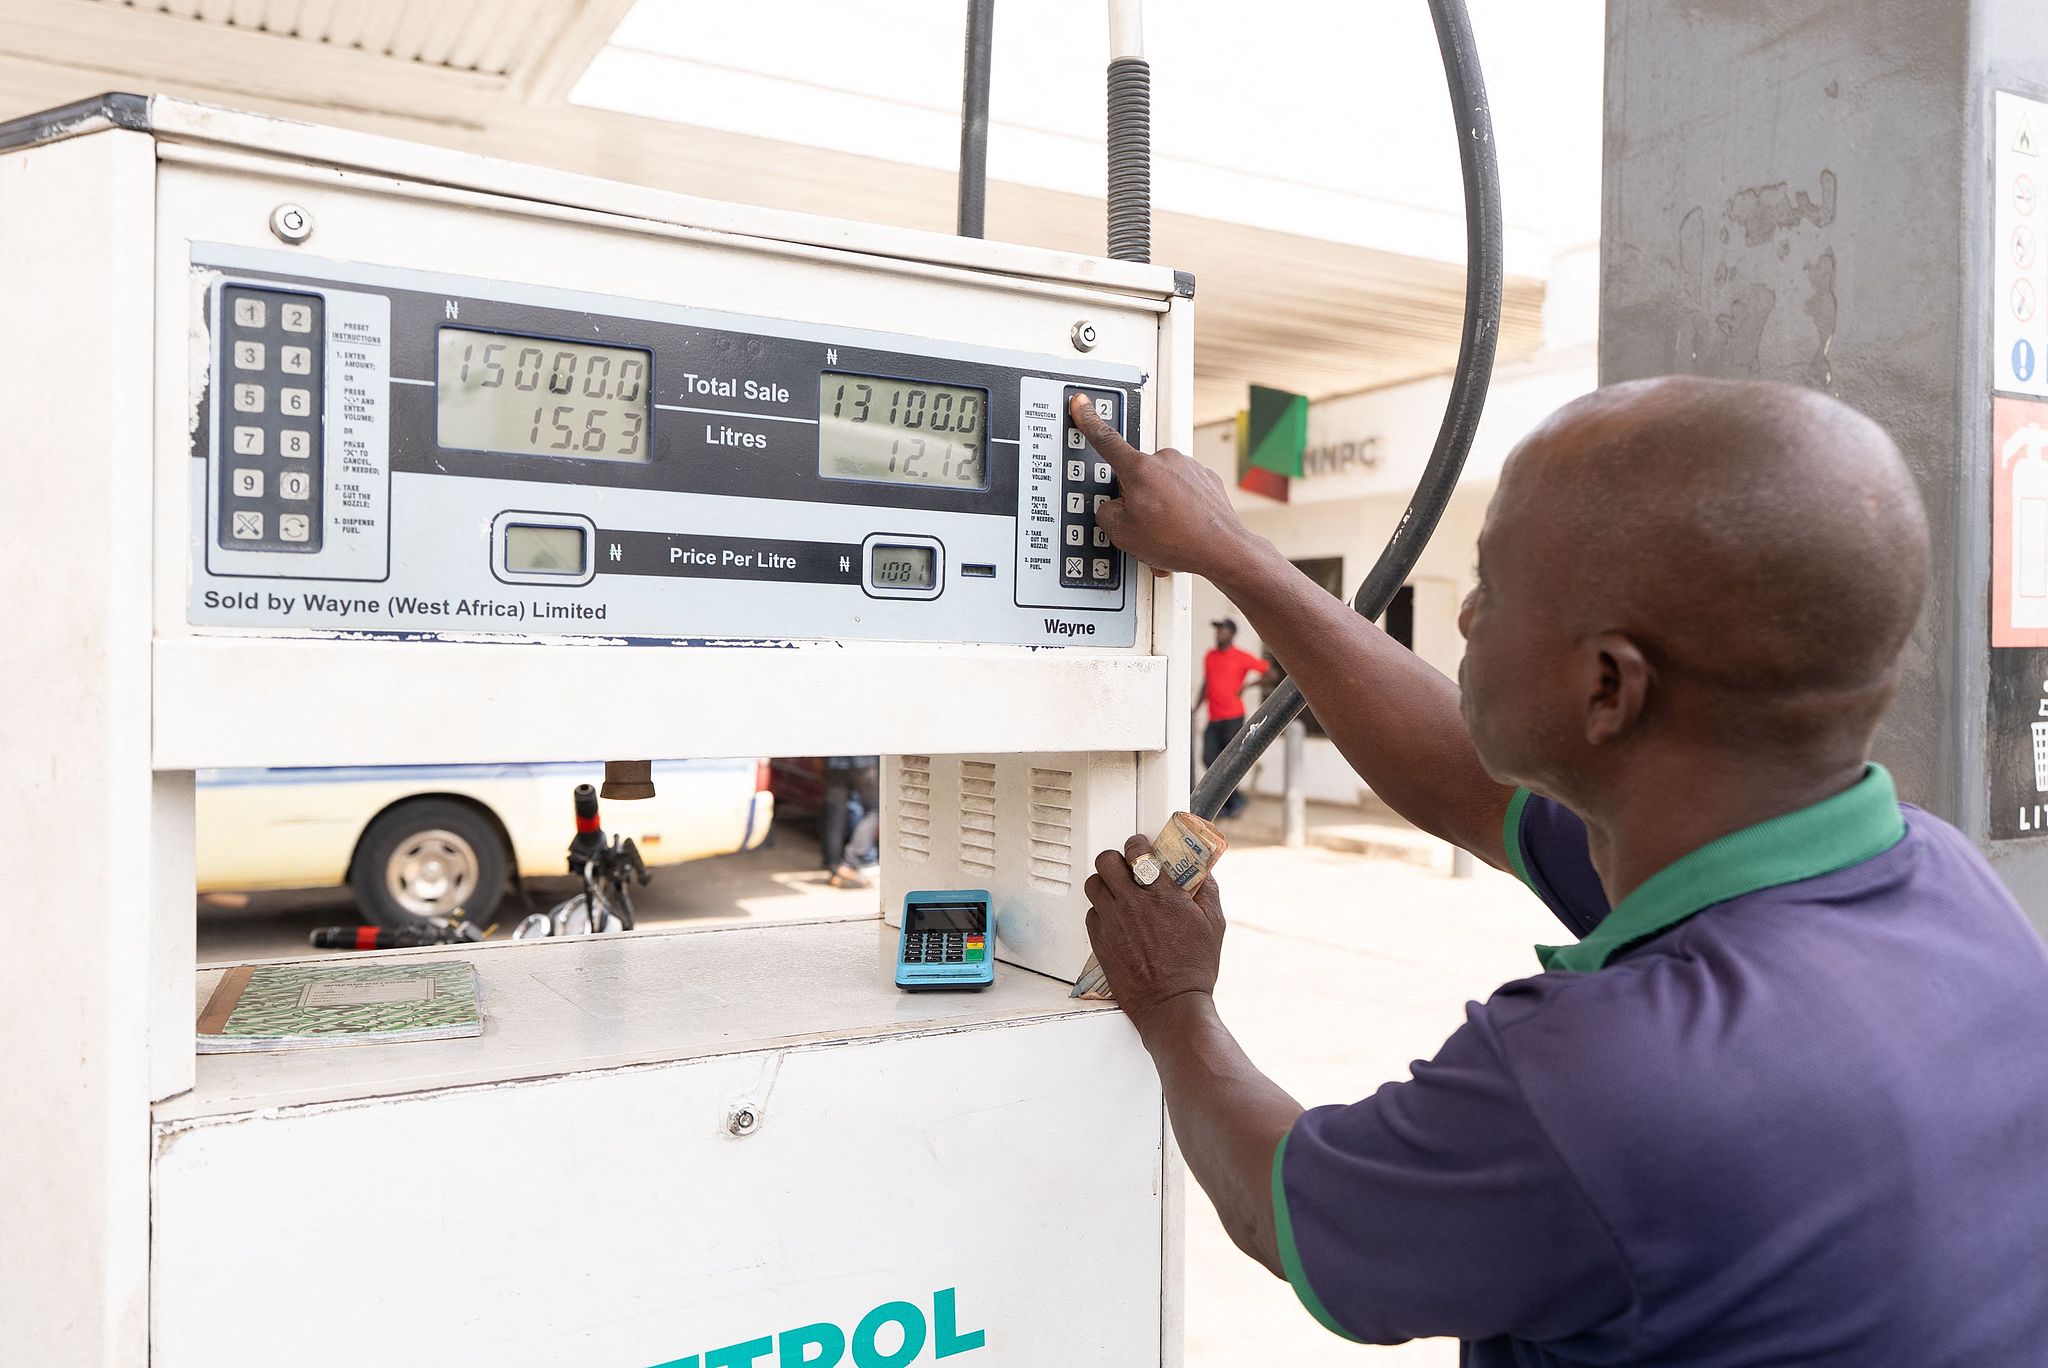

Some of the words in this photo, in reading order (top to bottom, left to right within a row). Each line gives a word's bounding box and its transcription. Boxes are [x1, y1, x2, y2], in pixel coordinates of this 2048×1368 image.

[246, 305, 256, 321] 1
[291, 311, 302, 326] 2
[344, 323, 369, 332] PRESET
[332, 332, 381, 343] INSTRUCTIONS
[245, 348, 255, 364] 3
[290, 354, 302, 368] 4
[345, 352, 366, 360] ENTER
[460, 343, 644, 402] 15000.0
[344, 388, 365, 396] PRESS
[683, 373, 738, 398] Total
[743, 378, 790, 403] Sale
[244, 390, 255, 405] 5
[291, 395, 301, 410] 6
[833, 384, 977, 433] 13100.0
[1025, 410, 1056, 418] INSTRUCTIONS
[530, 405, 642, 455] 15.63
[705, 425, 768, 449] Litres
[244, 434, 254, 448] 7
[290, 437, 301, 452] 8
[887, 438, 978, 481] 12.12
[243, 475, 254, 491] 9
[290, 478, 300, 494] 0
[342, 518, 375, 526] DISPENSE
[669, 548, 718, 567] Price
[722, 549, 752, 568] Per
[756, 551, 796, 569] Litre
[881, 562, 925, 582] 1081
[204, 591, 259, 610] Sold
[267, 592, 295, 616] by
[303, 595, 380, 618] Wayne
[387, 596, 450, 620] (West
[456, 598, 526, 621] Africa)
[532, 601, 607, 620] Limited
[1044, 619, 1095, 637] Wayne
